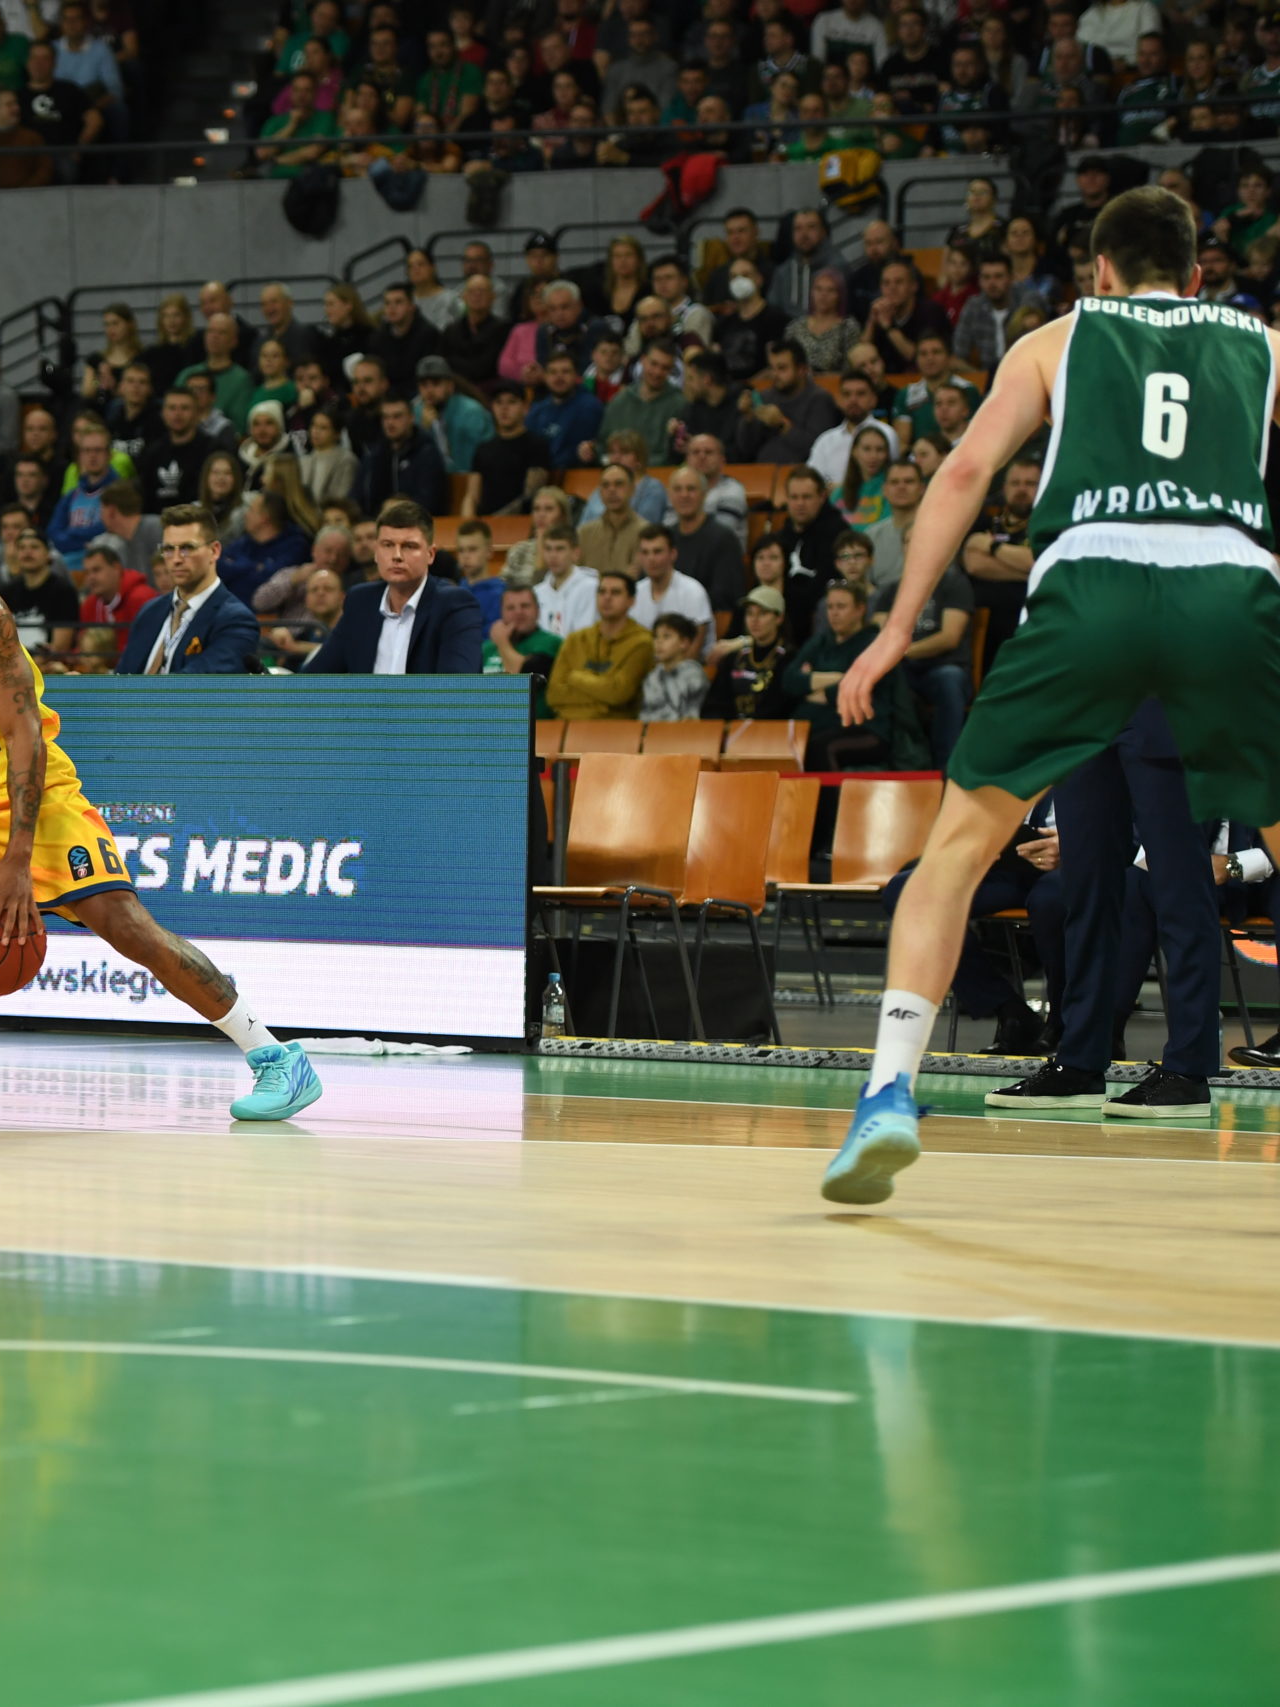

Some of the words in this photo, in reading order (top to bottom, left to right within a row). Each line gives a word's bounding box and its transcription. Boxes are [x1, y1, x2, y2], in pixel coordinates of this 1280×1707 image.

[1141, 372, 1190, 460] 6
[96, 836, 124, 875] 6
[182, 835, 362, 897] MEDIC
